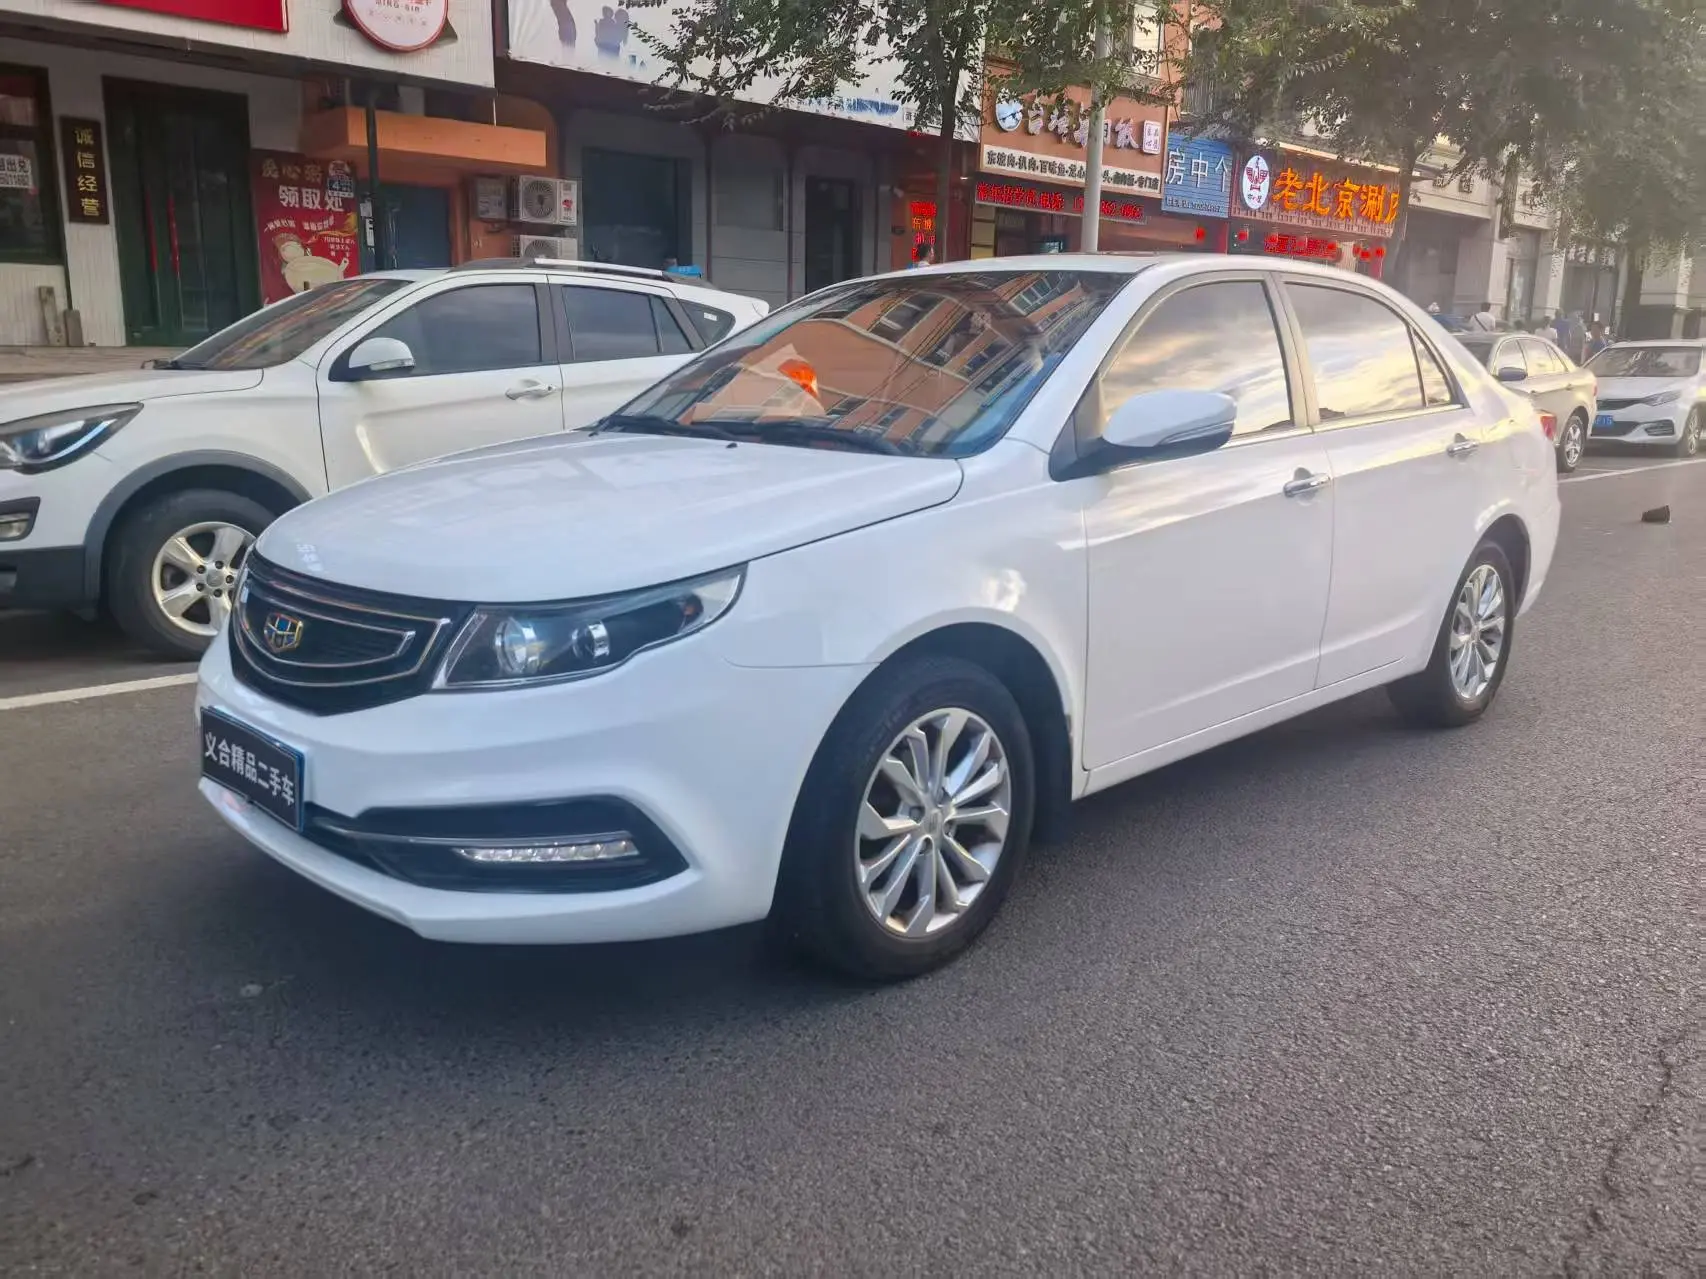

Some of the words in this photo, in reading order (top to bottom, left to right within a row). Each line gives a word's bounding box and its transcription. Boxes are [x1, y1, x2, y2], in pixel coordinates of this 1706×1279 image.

[74, 127, 100, 217] 诚信经营
[204, 731, 295, 806] 义合精品二手车
